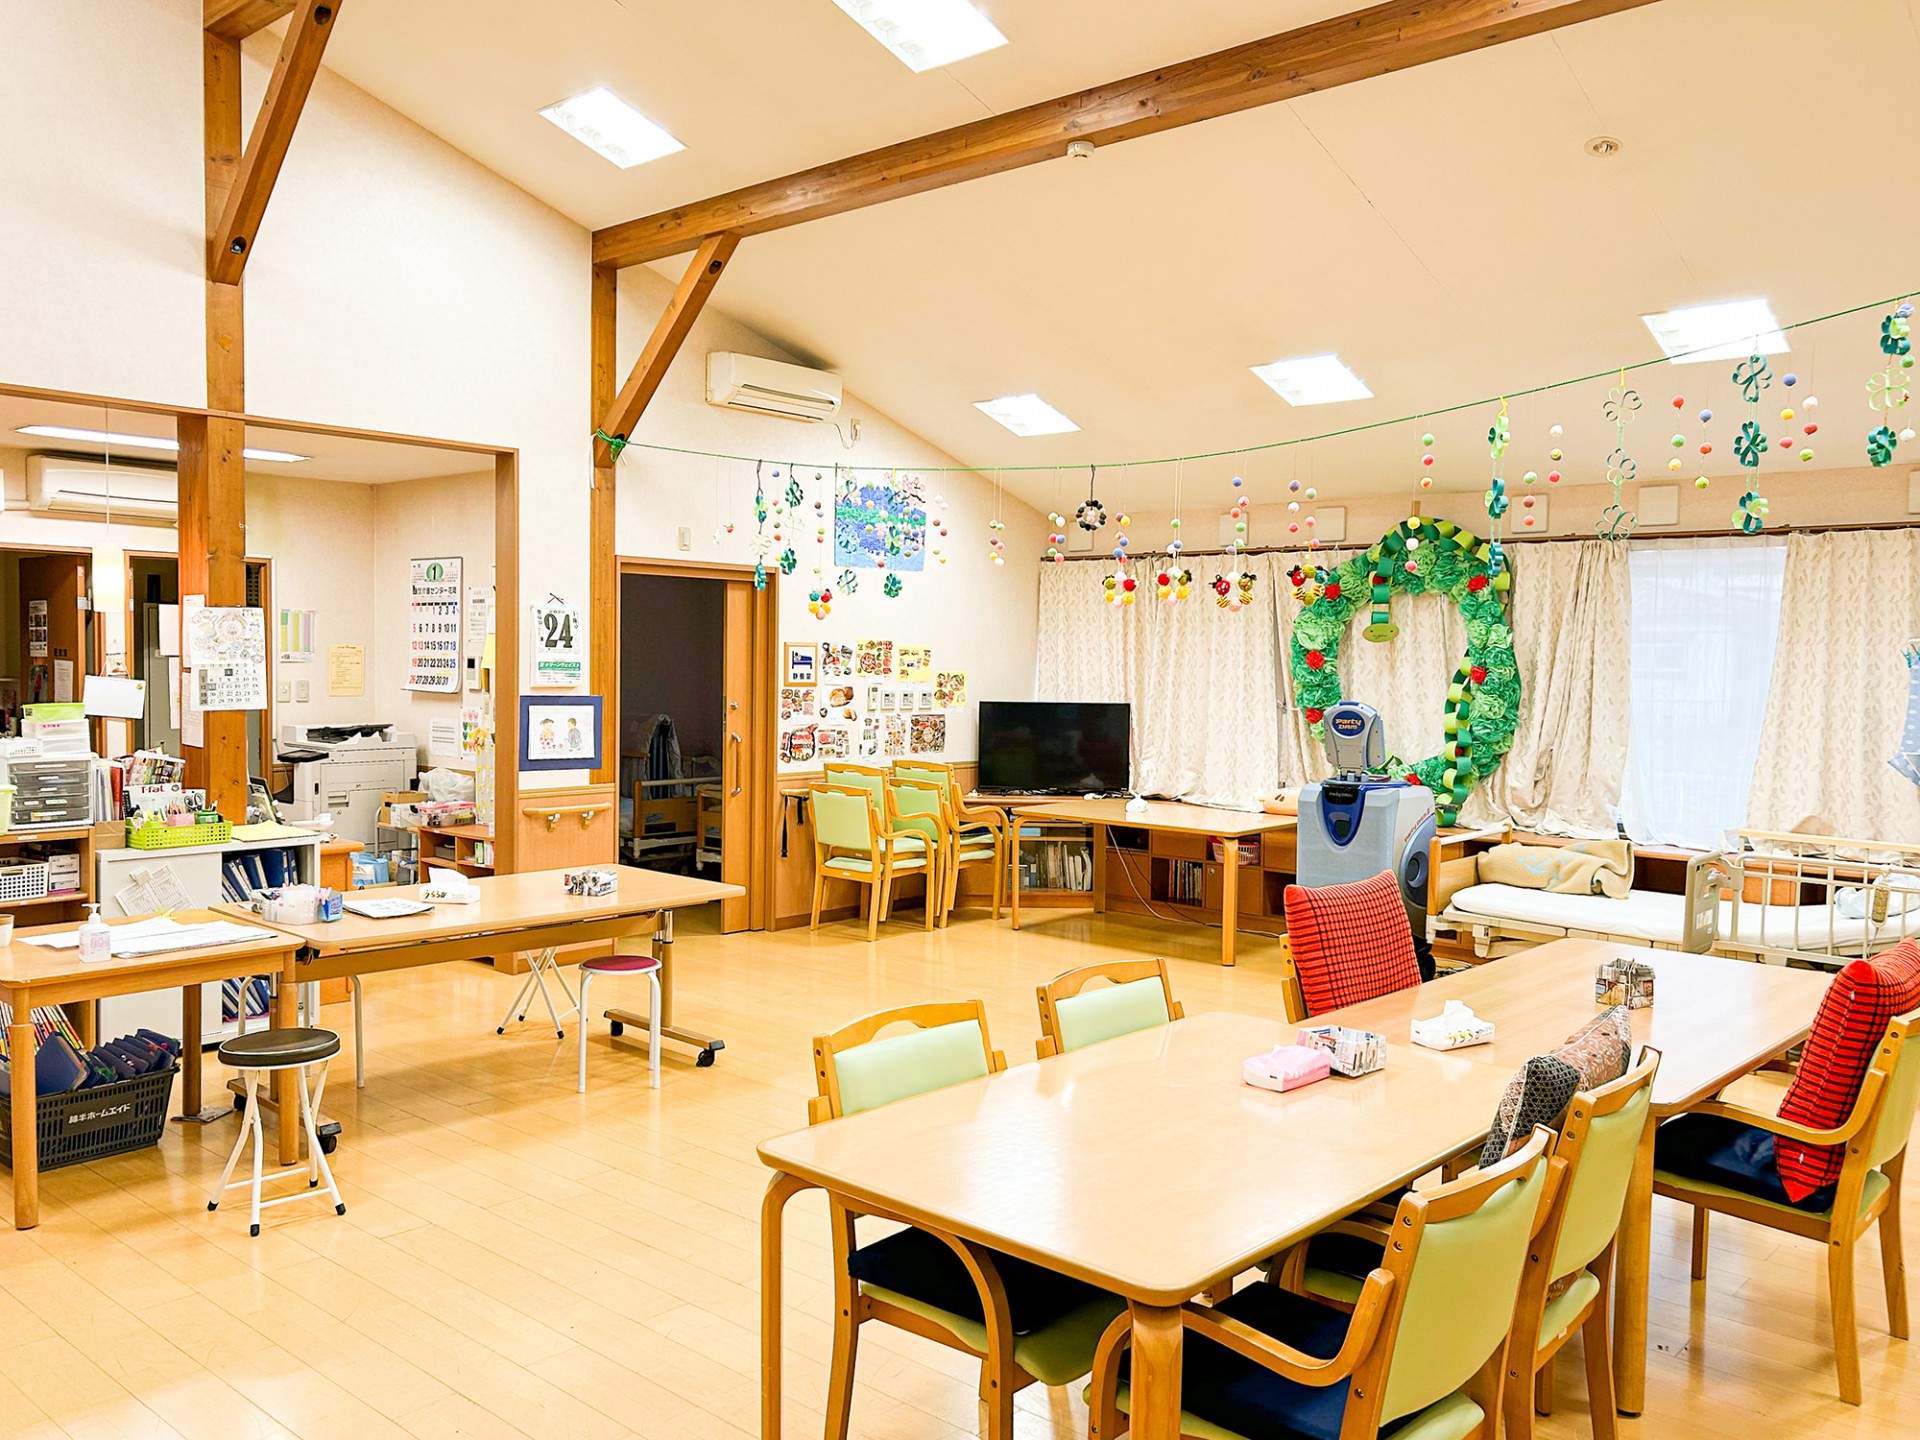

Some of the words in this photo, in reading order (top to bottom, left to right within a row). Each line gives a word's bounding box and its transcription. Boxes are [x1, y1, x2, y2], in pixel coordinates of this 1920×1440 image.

[432, 564, 437, 580] 1
[543, 613, 574, 648] 24
[140, 785, 165, 794] T-fal
